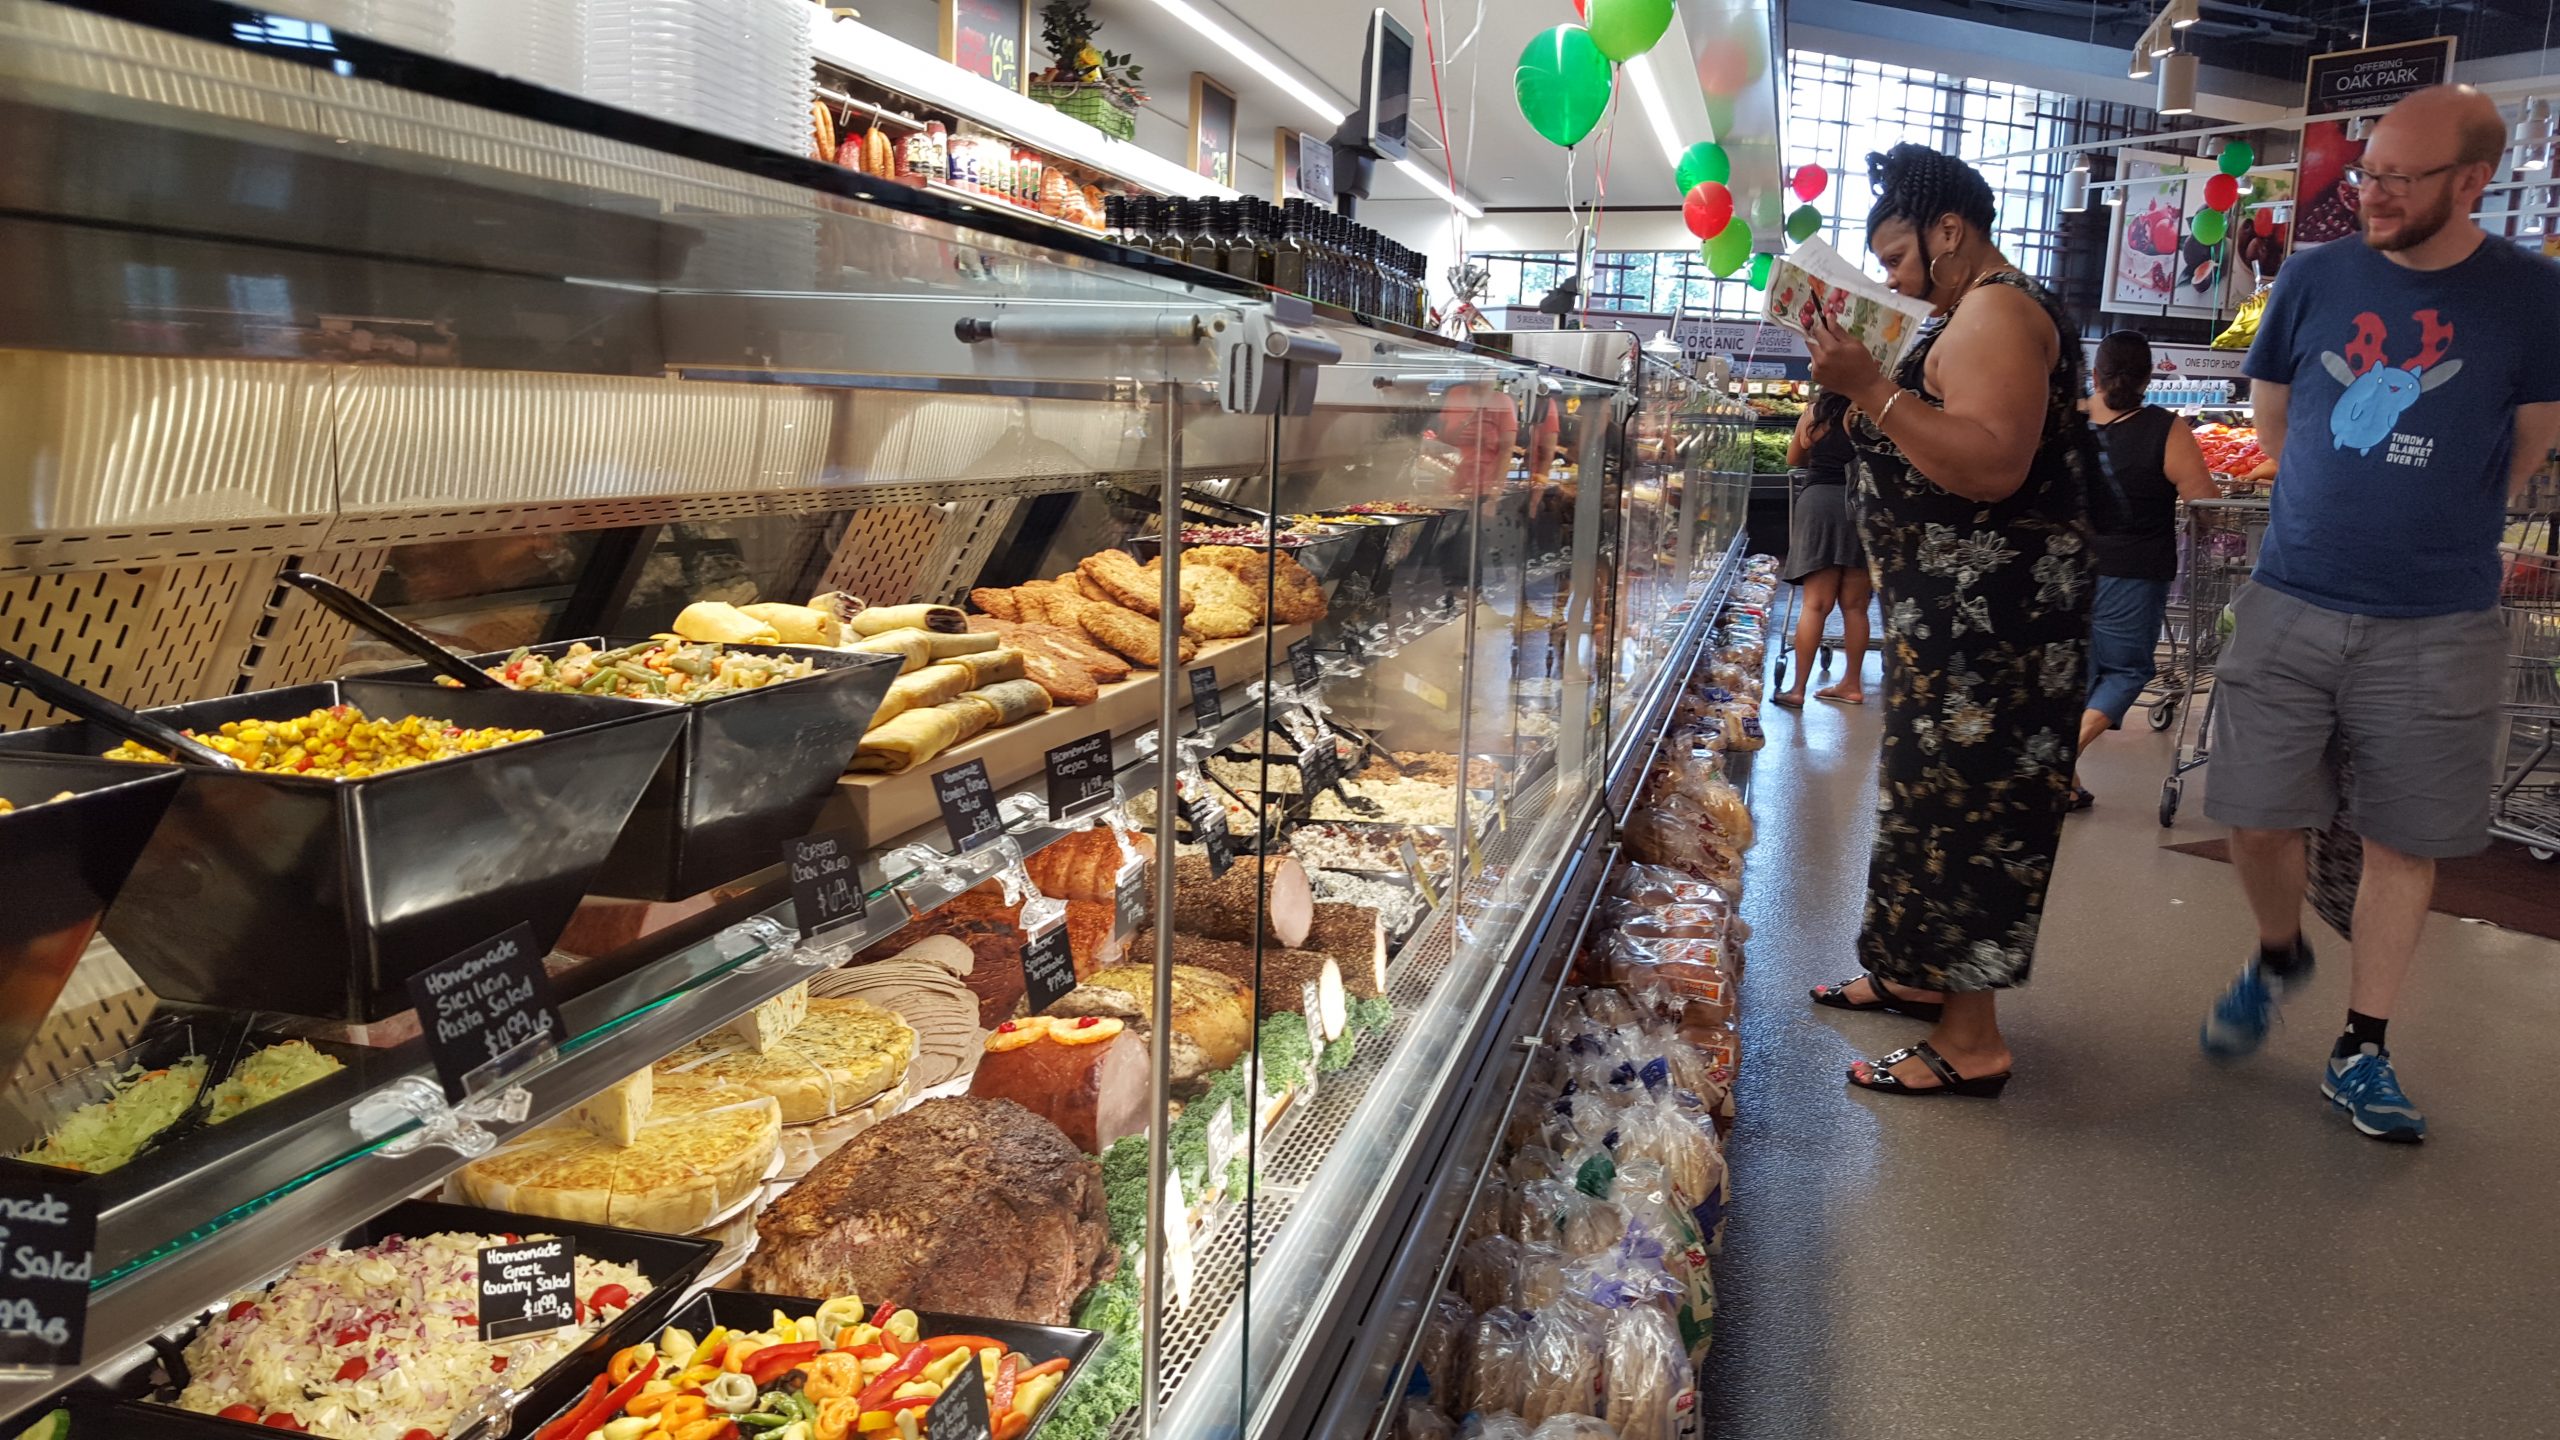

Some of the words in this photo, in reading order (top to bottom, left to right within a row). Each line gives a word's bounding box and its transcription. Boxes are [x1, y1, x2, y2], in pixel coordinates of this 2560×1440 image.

[2353, 58, 2403, 74] OFFERING
[2336, 73, 2373, 91] OAK
[2376, 67, 2419, 86] PARK
[1687, 335, 1744, 351] ORGANIC
[1756, 337, 1792, 348] ANSWER
[2185, 357, 2201, 368] ONE
[2202, 358, 2220, 368] STOP
[2221, 360, 2240, 370] SHOP
[2389, 442, 2433, 457] BLANKET
[2392, 432, 2424, 446] THROW
[2426, 437, 2434, 448] A
[2386, 453, 2412, 465] OVER
[2413, 457, 2428, 468] IT!
[821, 855, 850, 875] SALAD
[424, 940, 519, 996] Homemade
[436, 972, 512, 1018] Sicilian
[437, 1010, 484, 1044] Pasta
[487, 975, 534, 1018] Salad
[9, 1244, 92, 1281] Salad
[486, 1242, 562, 1265] Homemade
[502, 1262, 546, 1280] Greek
[483, 1279, 533, 1297] Country
[536, 1272, 571, 1292] Salad
